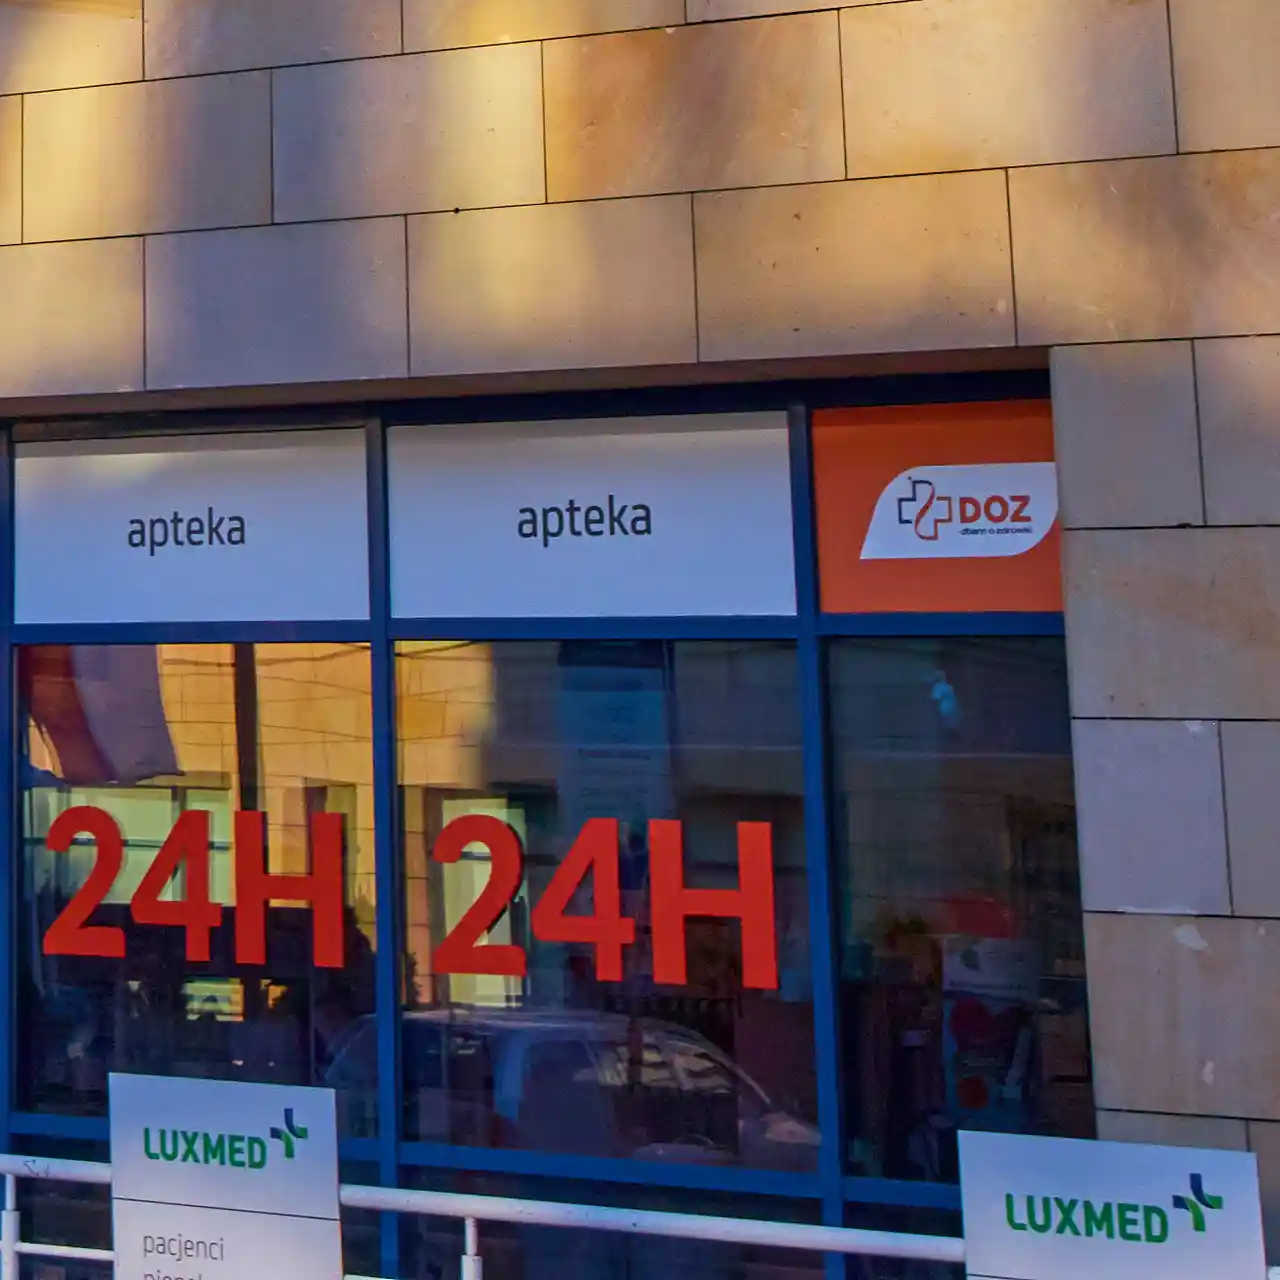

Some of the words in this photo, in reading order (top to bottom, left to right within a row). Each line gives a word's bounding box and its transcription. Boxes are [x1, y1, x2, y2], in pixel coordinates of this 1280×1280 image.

[128, 506, 246, 557] apteka
[518, 494, 652, 548] apteka
[959, 495, 1032, 524] DOZ
[42, 805, 345, 970] 24H
[432, 813, 778, 990] 24H
[143, 1127, 268, 1170] LUXMED
[1005, 1192, 1169, 1244] LUXMED
[143, 1233, 224, 1262] pacjenci
